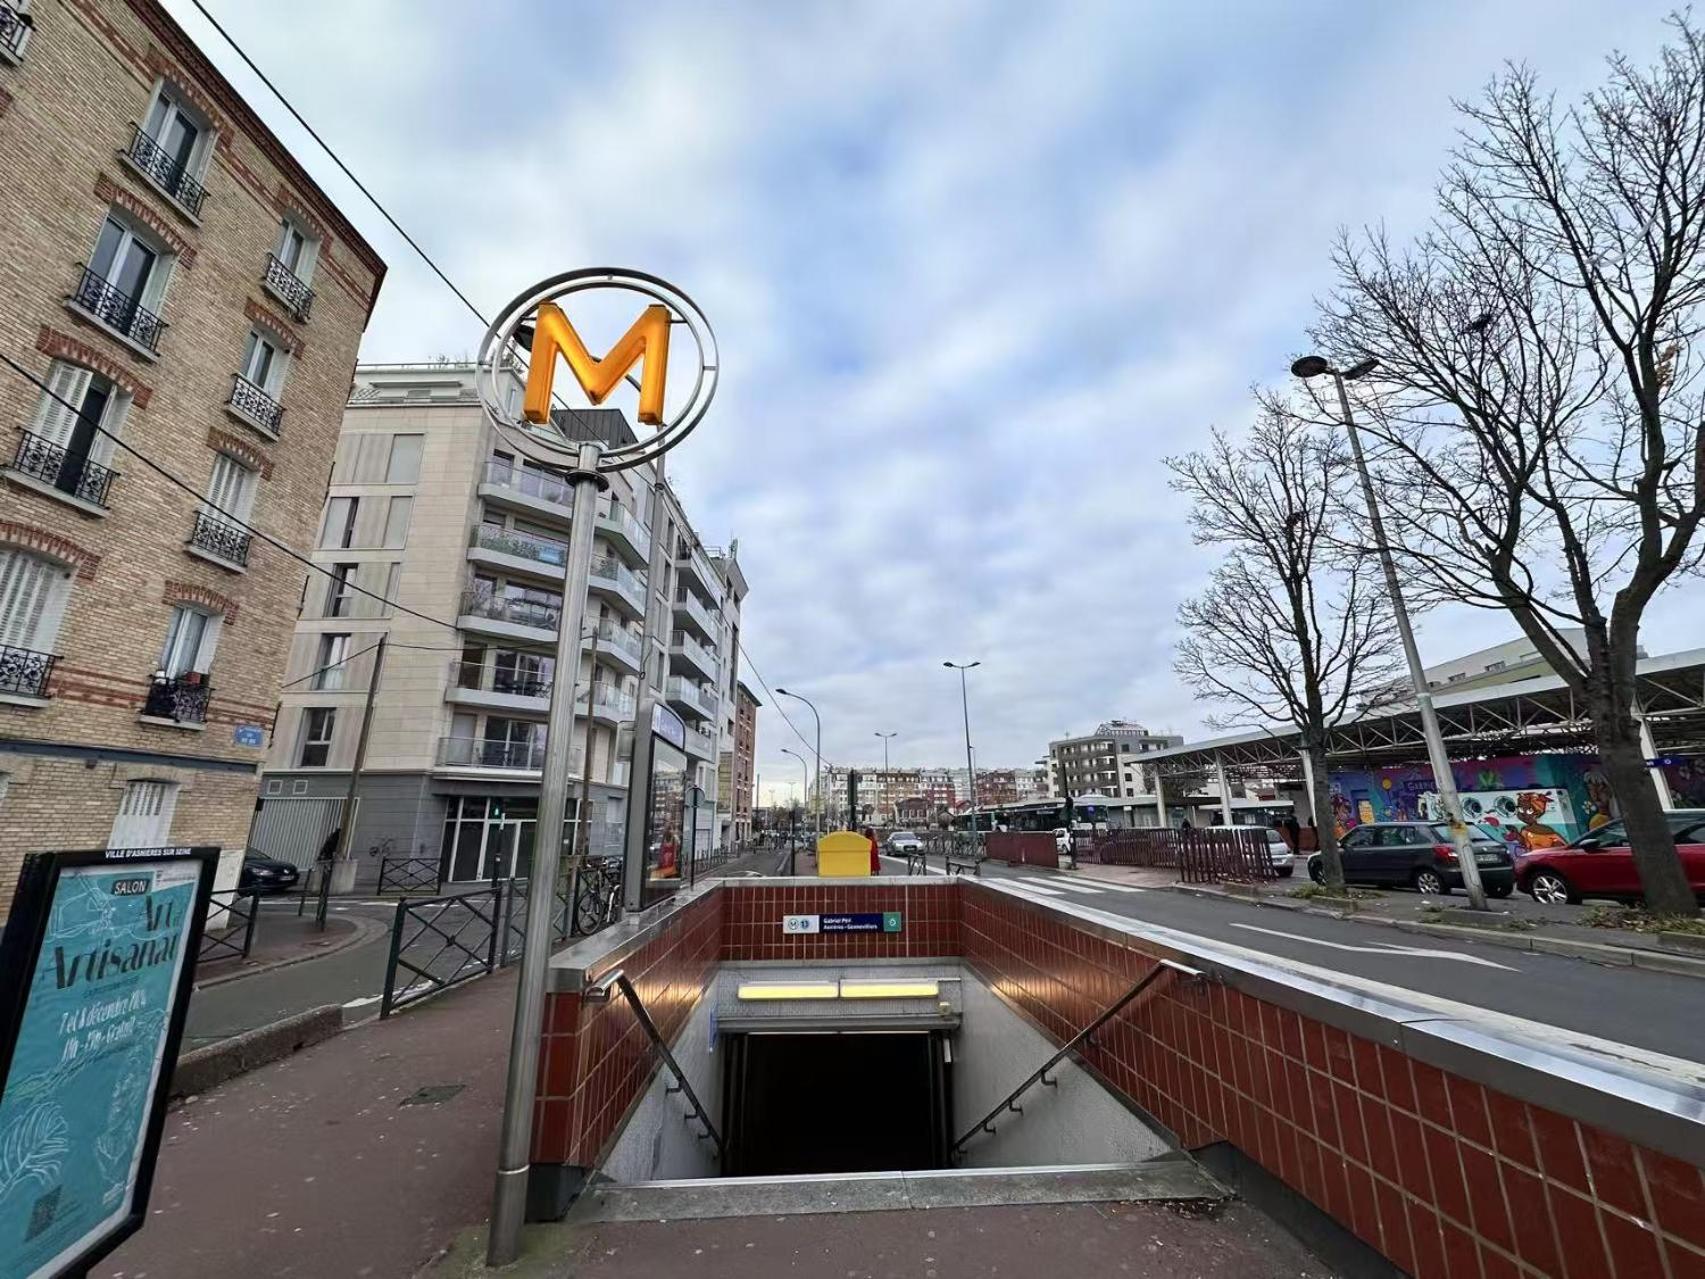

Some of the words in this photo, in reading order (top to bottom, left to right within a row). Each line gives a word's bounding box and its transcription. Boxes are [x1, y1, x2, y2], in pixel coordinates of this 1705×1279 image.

[523, 302, 672, 425] M
[105, 848, 124, 858] VILLE
[163, 848, 175, 856] SUR
[175, 847, 192, 855] SEINE
[114, 880, 146, 895] SALON
[137, 895, 173, 931] Art
[41, 934, 178, 990] Artisanat
